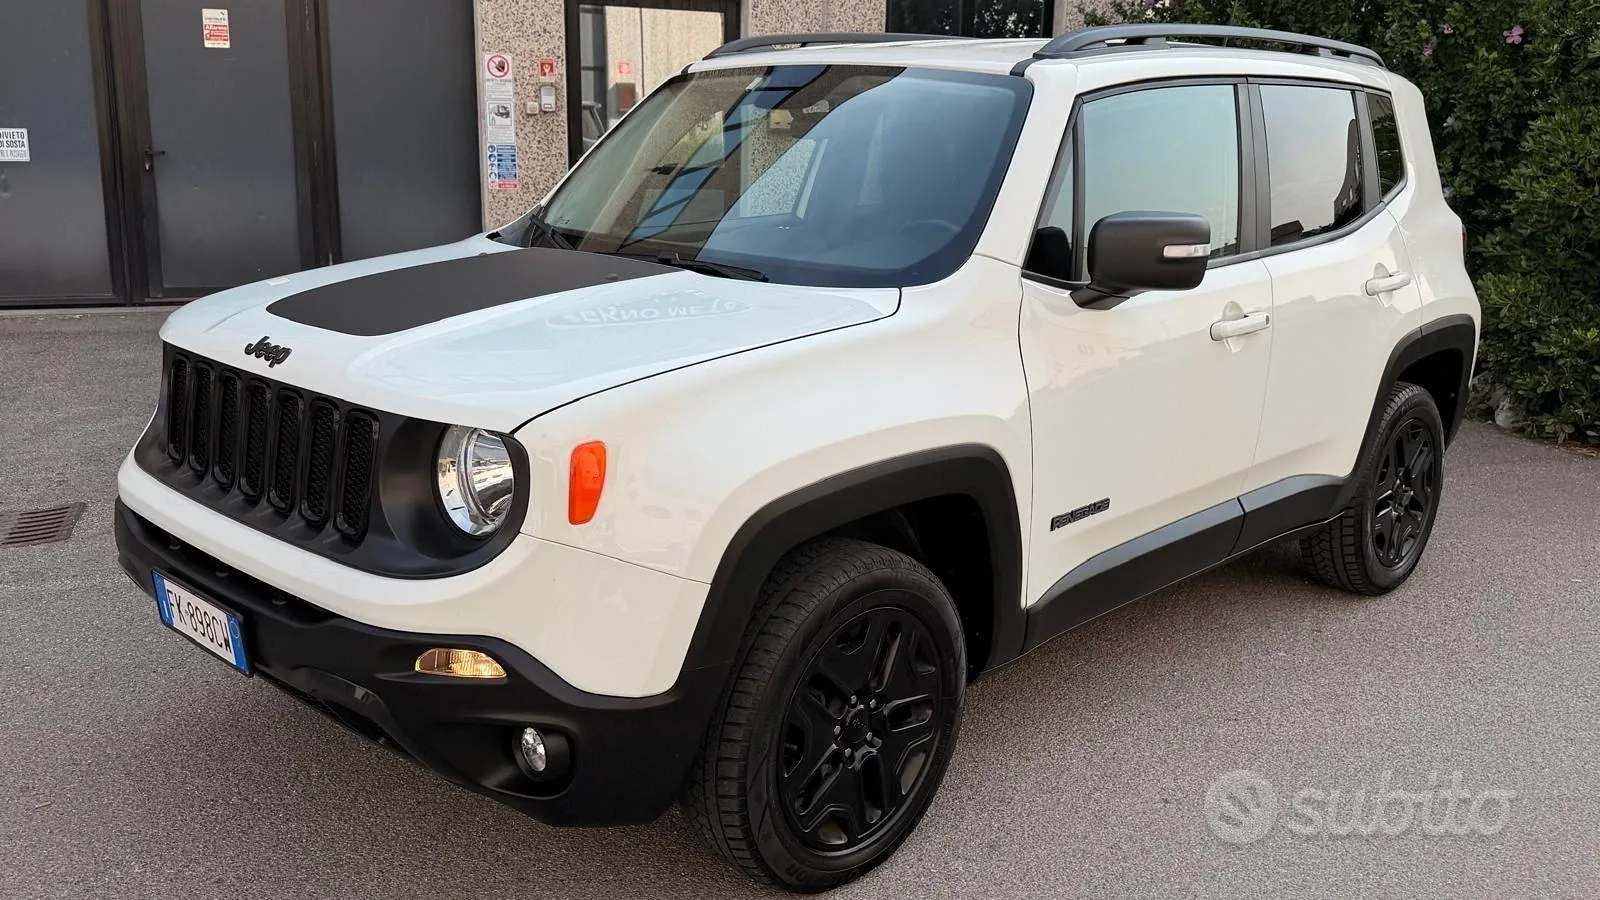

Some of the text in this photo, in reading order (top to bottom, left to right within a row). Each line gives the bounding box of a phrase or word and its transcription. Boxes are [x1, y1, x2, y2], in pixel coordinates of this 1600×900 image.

[6, 140, 25, 148] SOSTA
[244, 336, 292, 368] Jeep
[1050, 497, 1110, 531] RENEGADE
